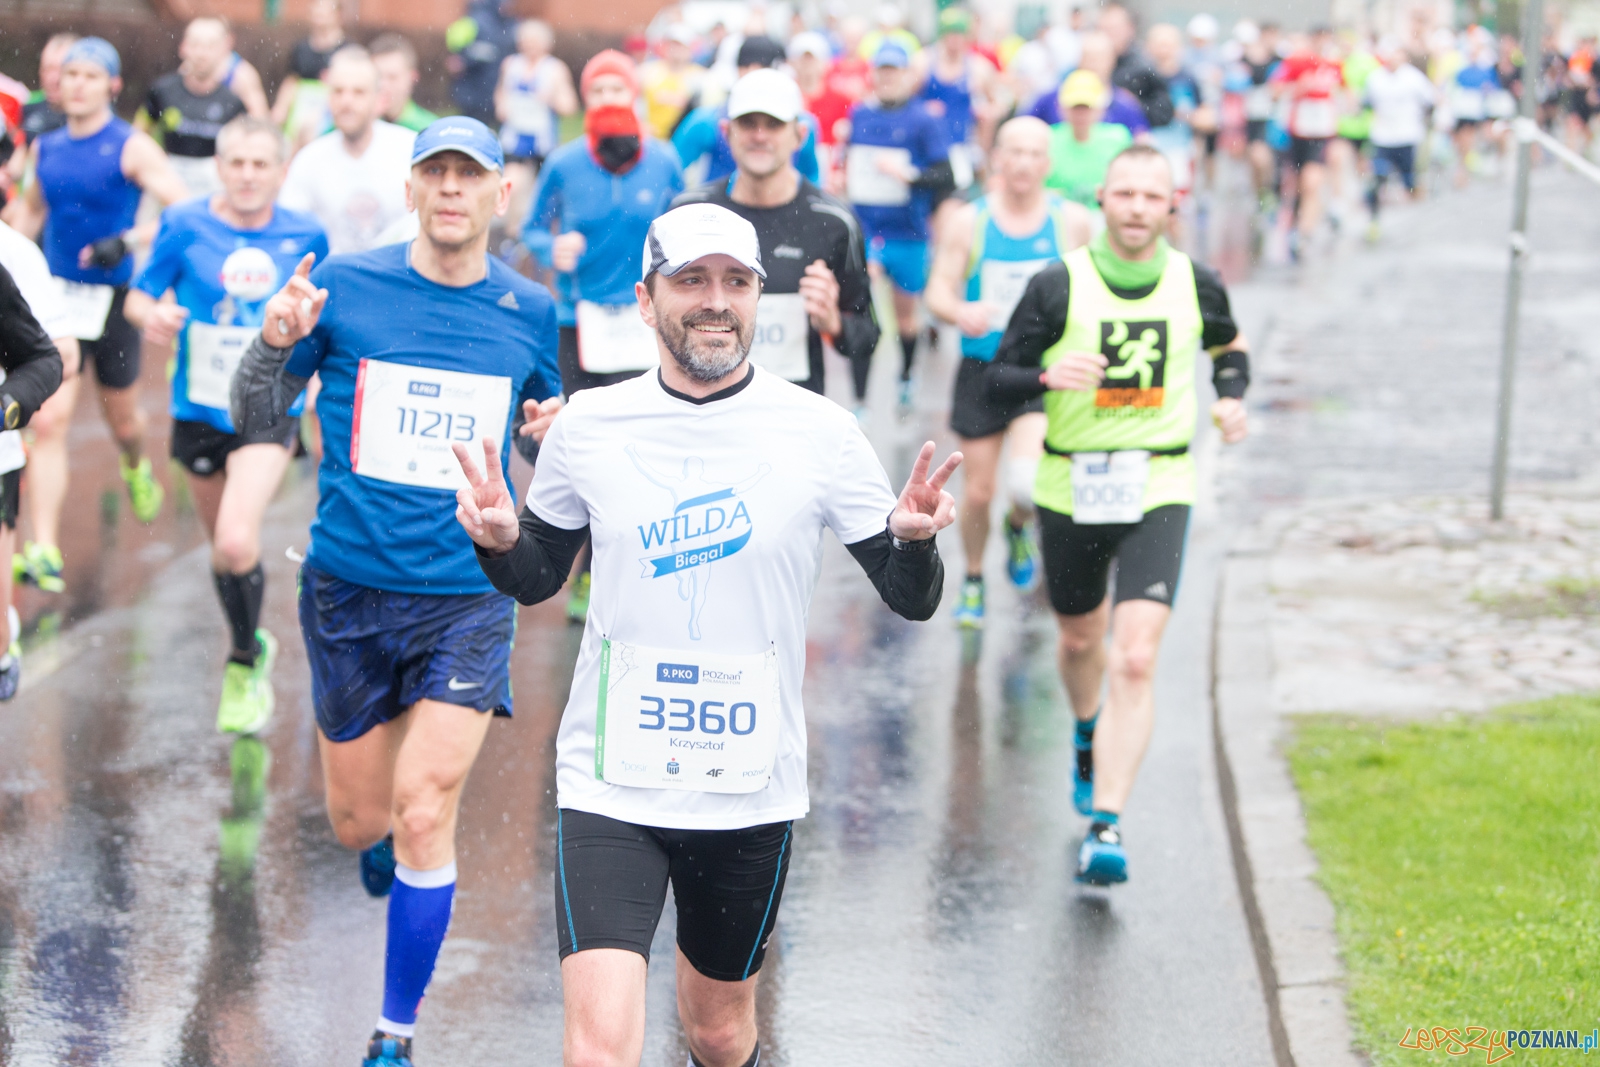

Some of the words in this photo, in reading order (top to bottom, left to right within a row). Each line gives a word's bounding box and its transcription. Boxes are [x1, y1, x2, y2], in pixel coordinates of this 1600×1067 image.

[397, 406, 476, 442] 11213
[637, 500, 752, 550] WILDA
[675, 543, 724, 568] Biega!
[639, 695, 757, 736] 3360
[669, 737, 726, 751] Krzysztof
